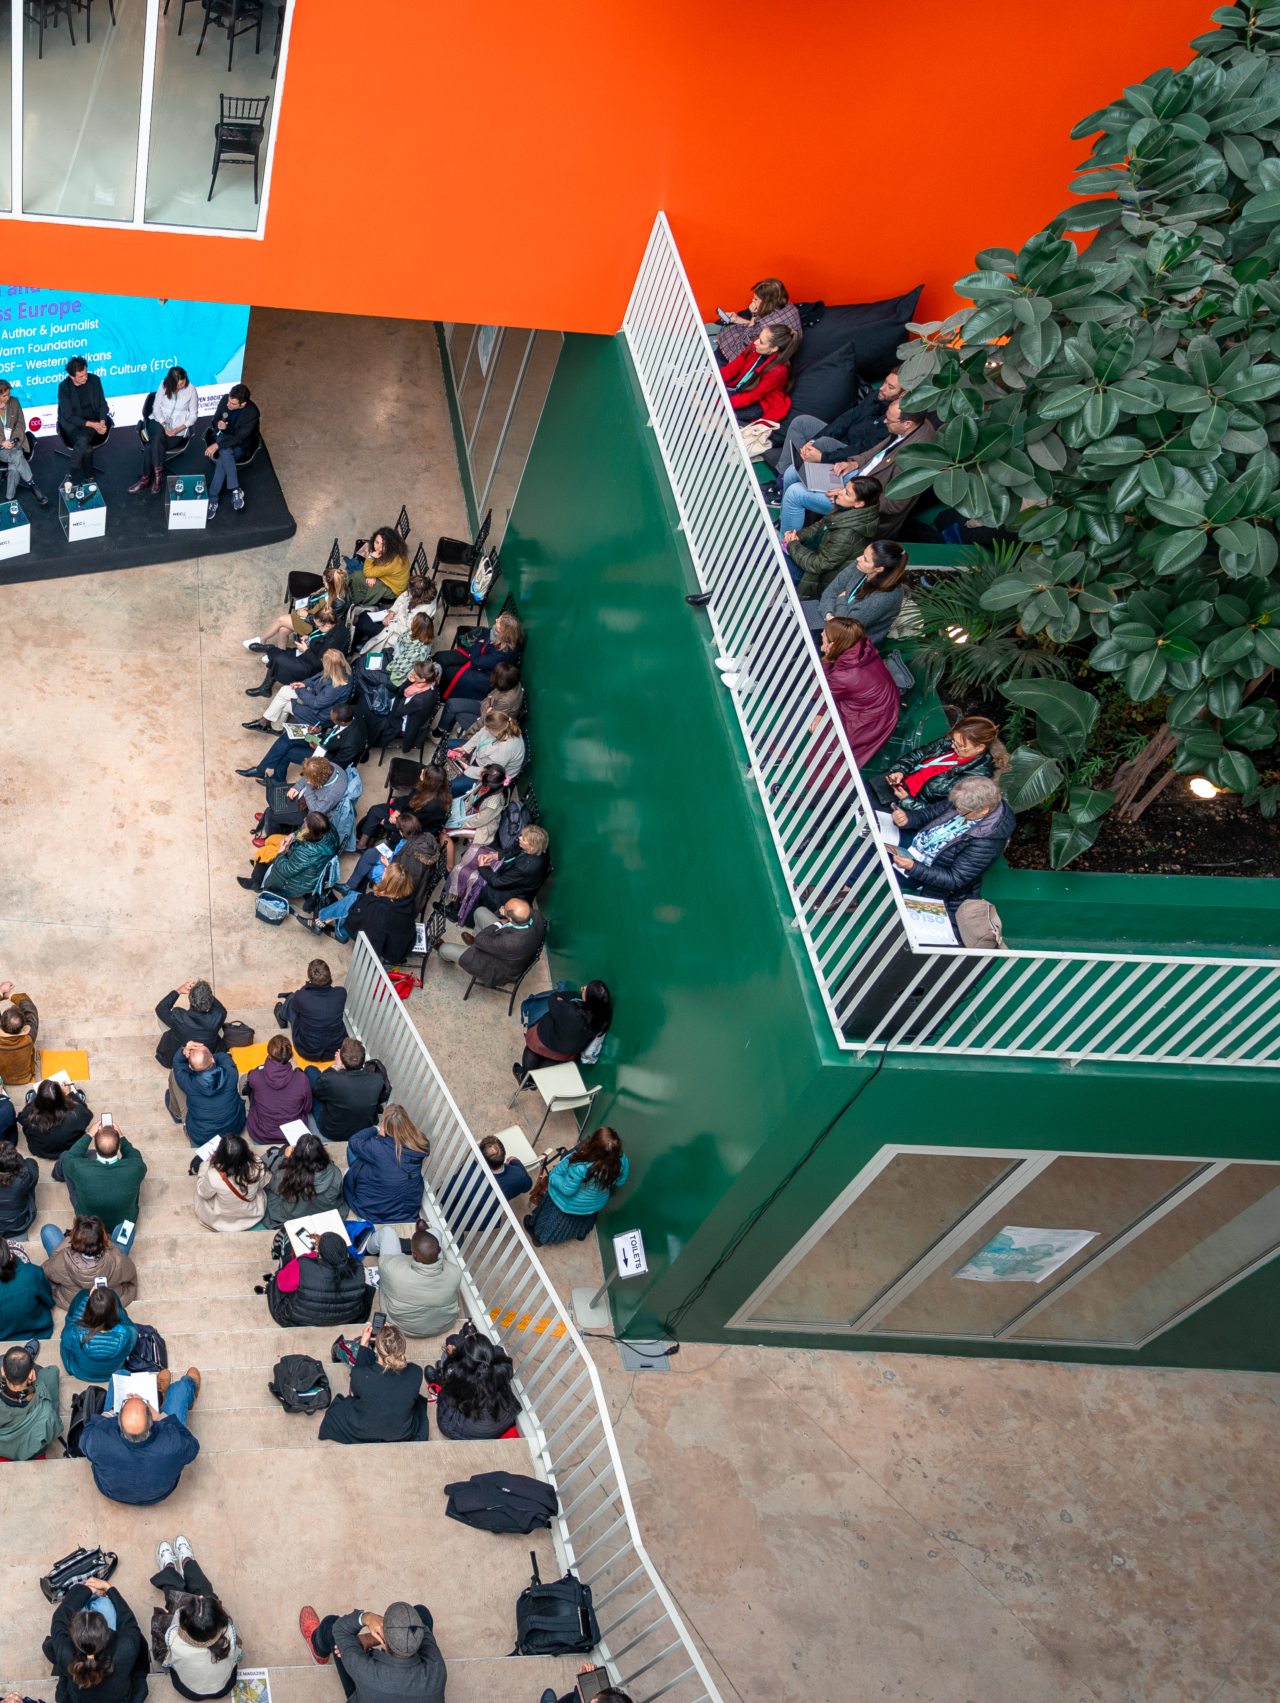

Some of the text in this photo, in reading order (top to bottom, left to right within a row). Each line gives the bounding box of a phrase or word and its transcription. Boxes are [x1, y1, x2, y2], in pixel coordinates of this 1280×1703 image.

[18, 300, 82, 320] Europe
[1, 327, 37, 340] Author
[39, 325, 47, 335] &
[50, 319, 99, 337] journalist
[28, 338, 88, 353] Foundation
[25, 356, 68, 370] Western
[109, 363, 148, 375] Culture
[150, 356, 178, 372] (ETC)
[910, 912, 946, 925] OSLO
[629, 1235, 642, 1269] TOILETS
